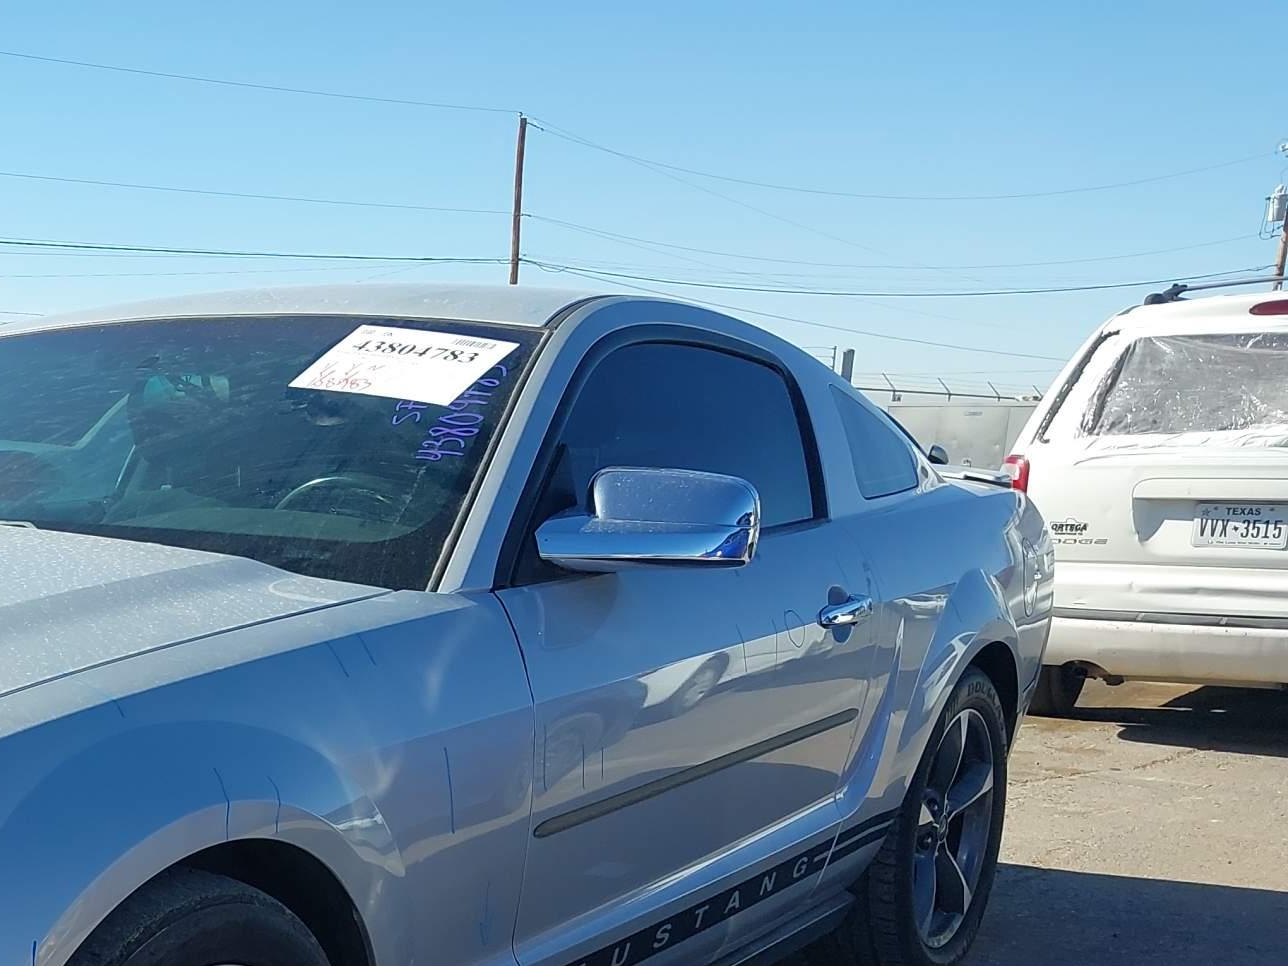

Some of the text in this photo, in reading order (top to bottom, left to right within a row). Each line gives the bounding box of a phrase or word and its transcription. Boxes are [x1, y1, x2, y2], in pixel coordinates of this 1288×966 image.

[352, 339, 480, 364] 43804783
[1225, 507, 1262, 516] TEXAS
[1051, 523, 1087, 532] ORTEGA
[1199, 518, 1284, 539] VVX 3515
